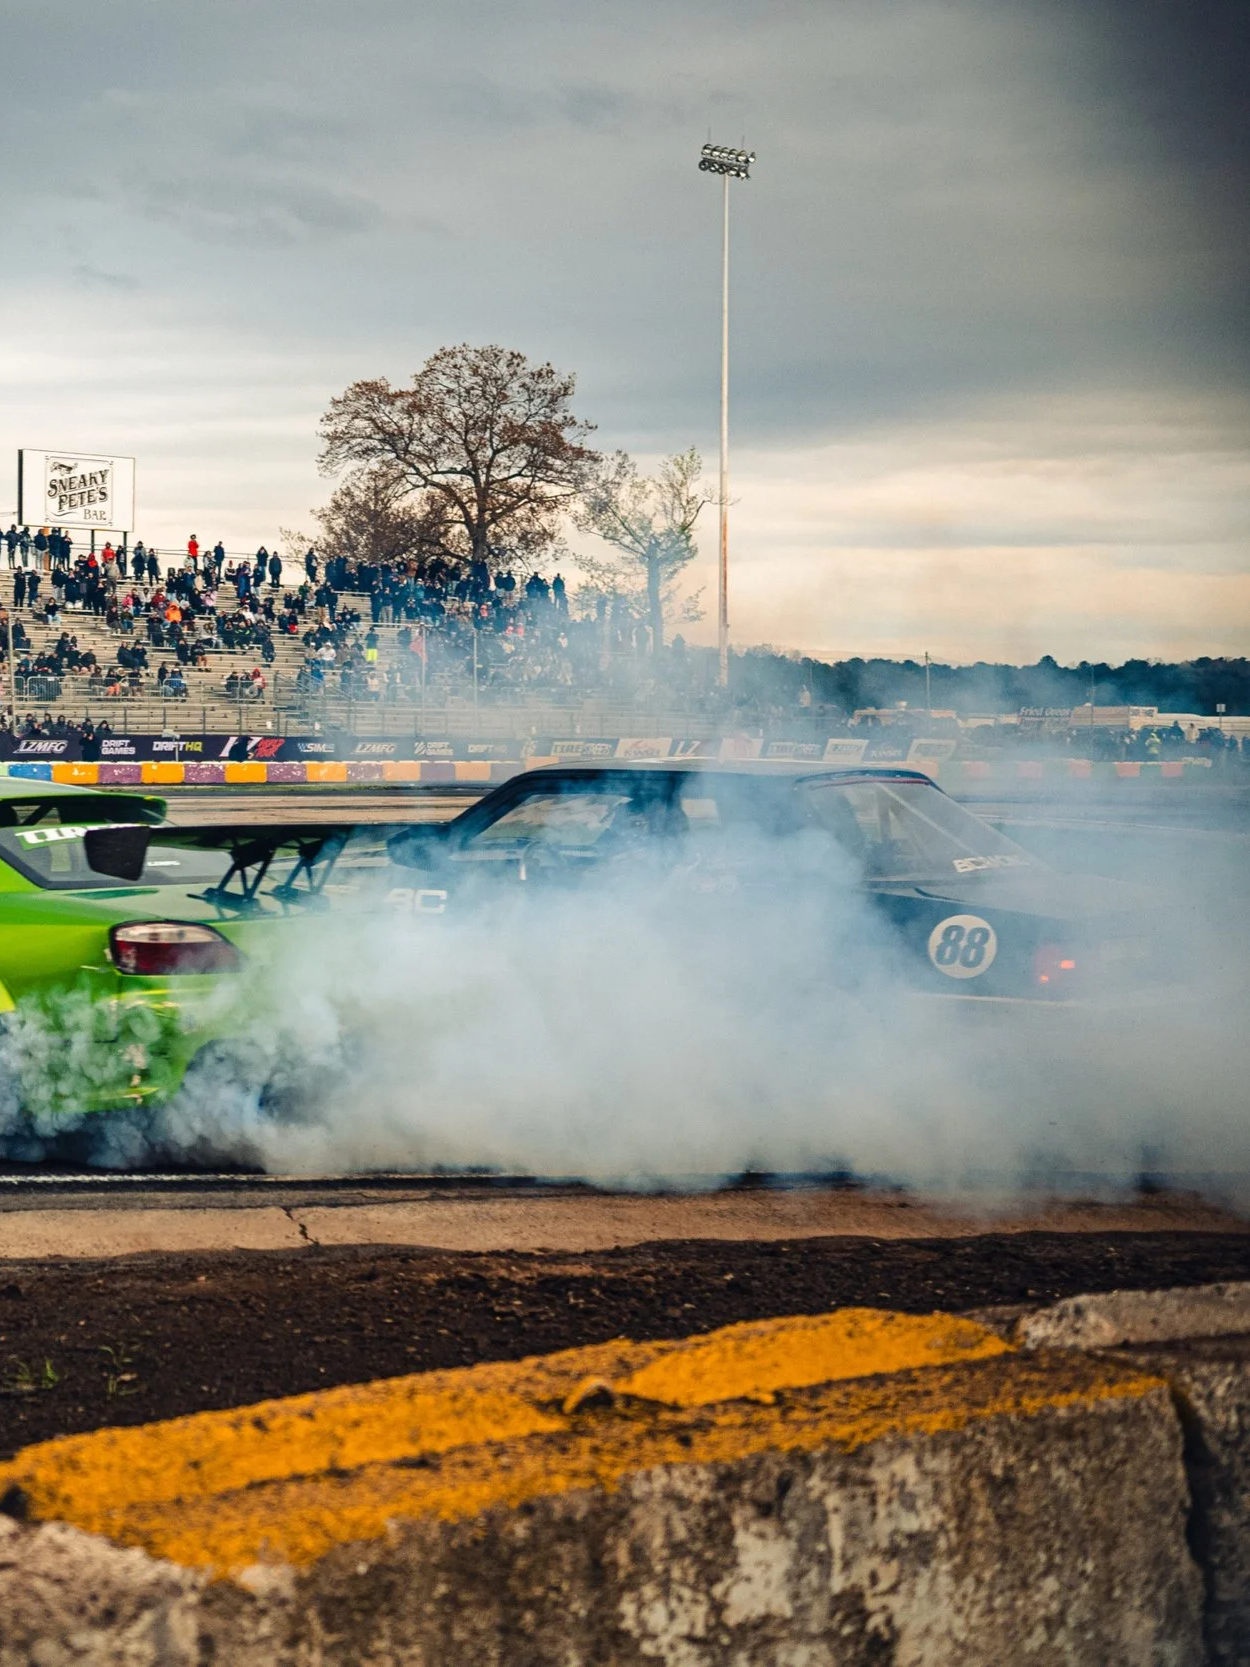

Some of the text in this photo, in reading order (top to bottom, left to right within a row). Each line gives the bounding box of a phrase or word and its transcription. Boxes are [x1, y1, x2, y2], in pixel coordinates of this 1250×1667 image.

[47, 469, 110, 498] SNEAKY
[58, 486, 109, 512] PETE'S
[83, 508, 107, 520] BAR
[101, 747, 136, 755] GAMES
[935, 924, 990, 968] 88
